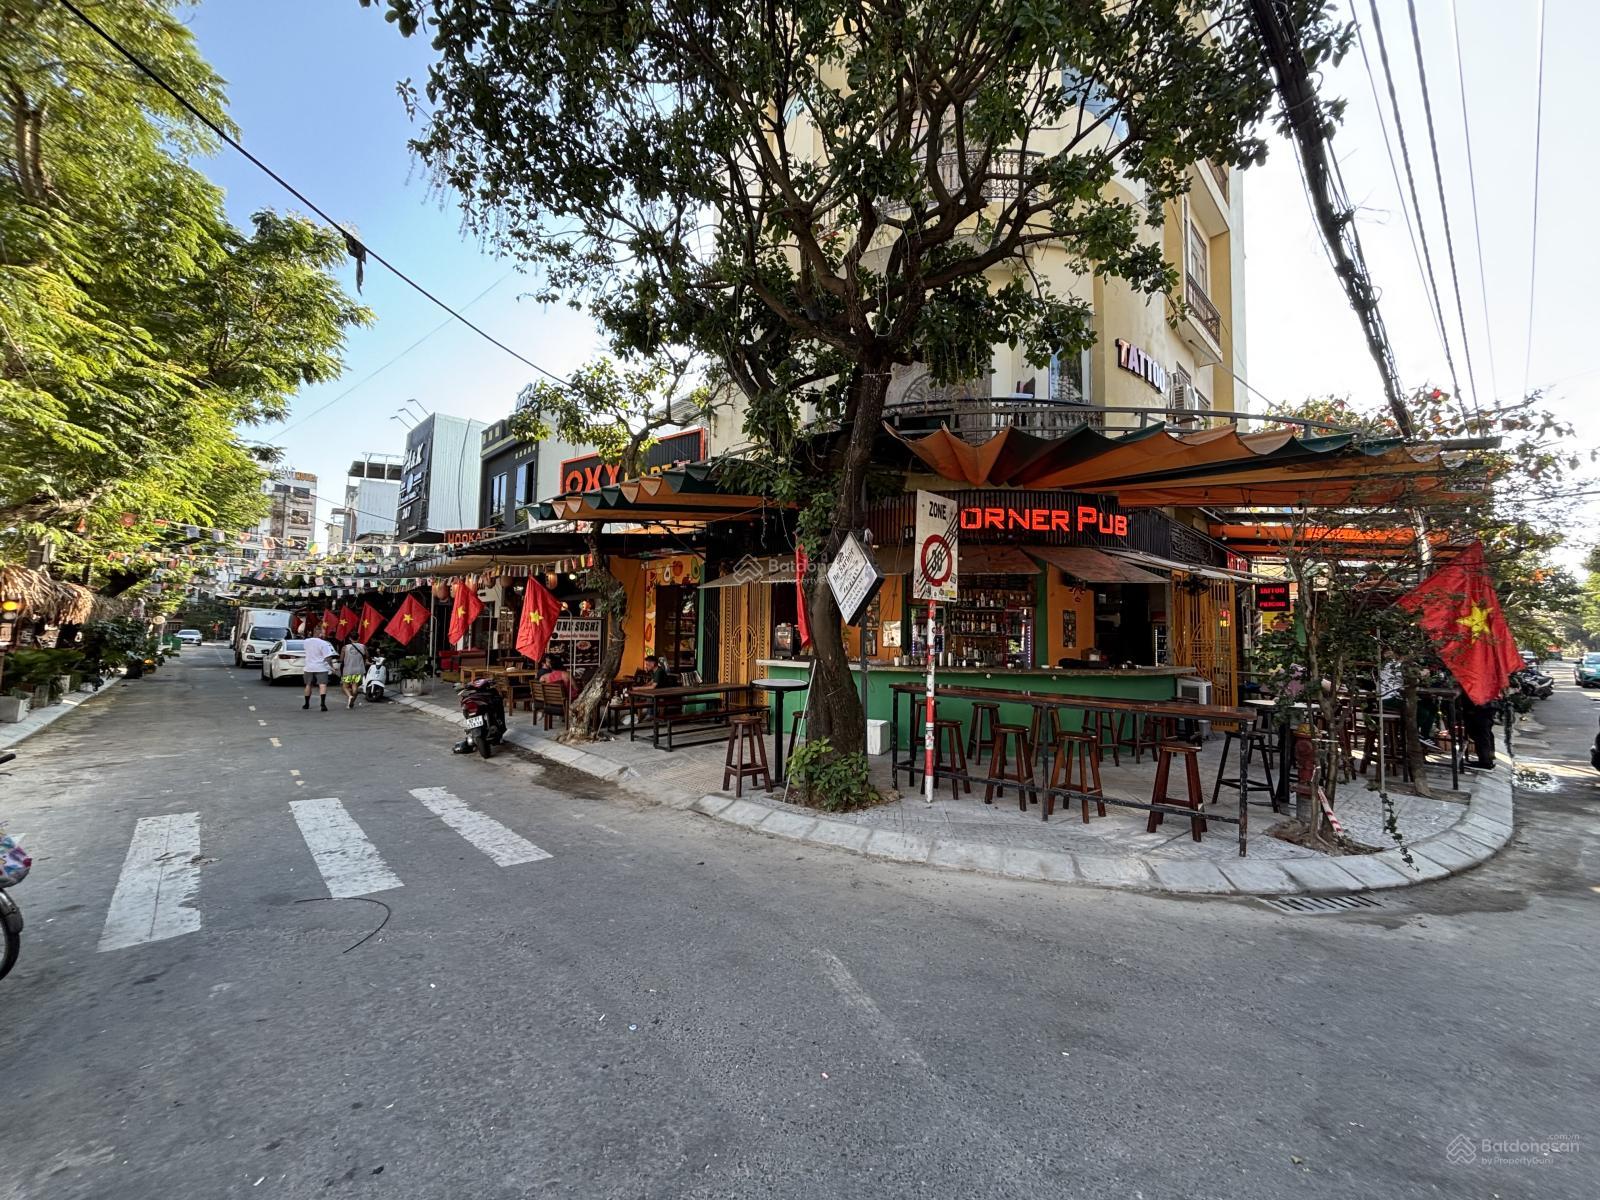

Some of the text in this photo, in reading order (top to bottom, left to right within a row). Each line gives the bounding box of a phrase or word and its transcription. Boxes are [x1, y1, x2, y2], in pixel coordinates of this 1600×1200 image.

[1115, 338, 1166, 394] TATTOO
[565, 463, 621, 492] OXY
[929, 500, 947, 520] ZONE
[960, 507, 1070, 532] ORNER
